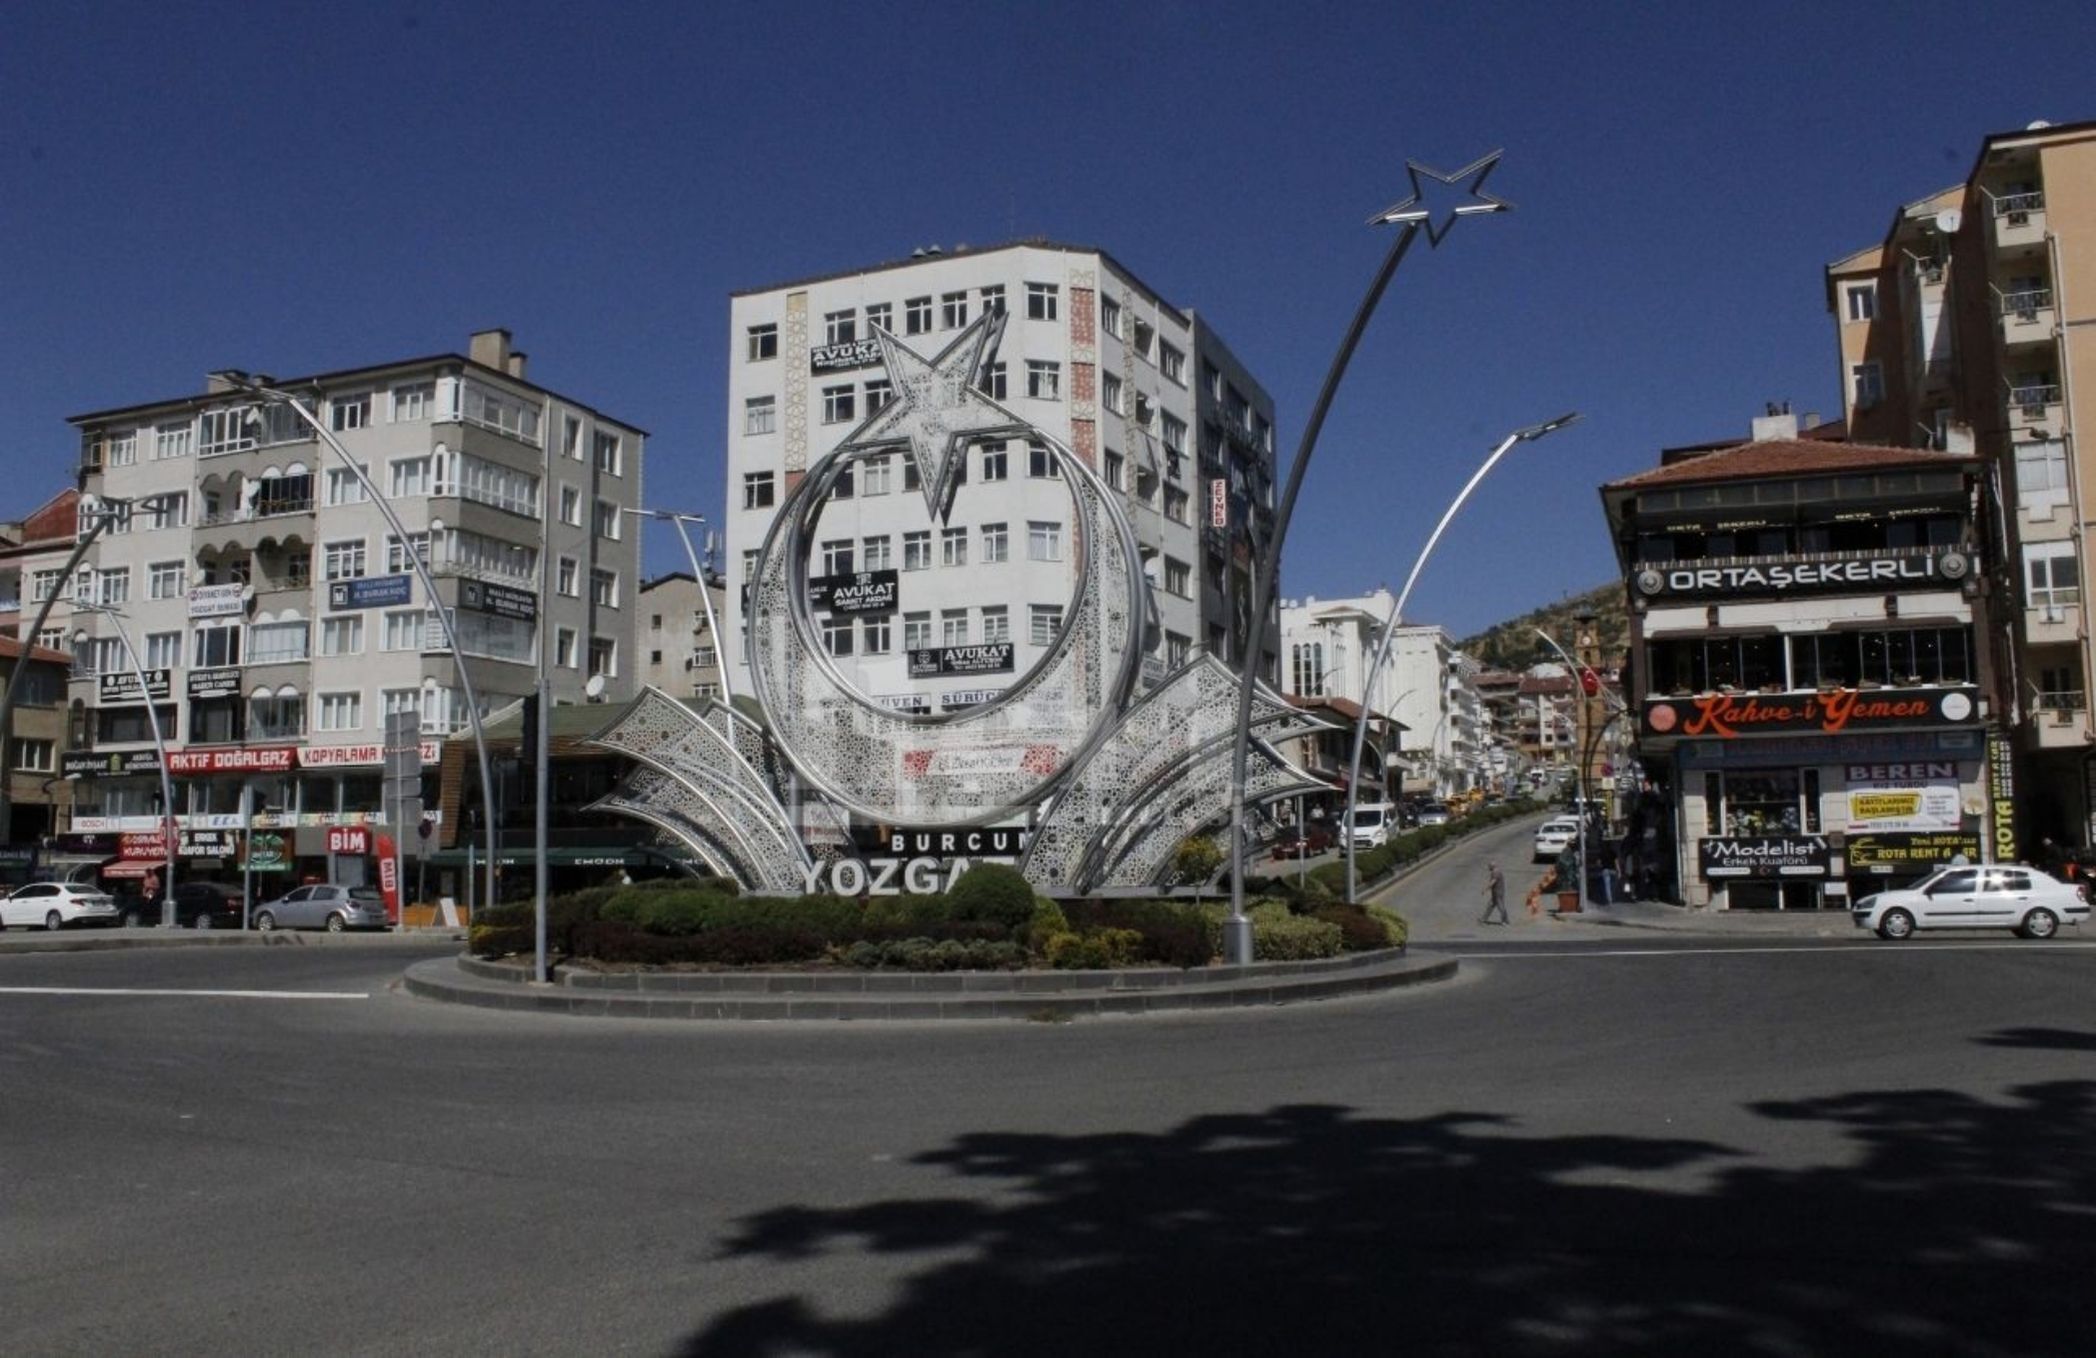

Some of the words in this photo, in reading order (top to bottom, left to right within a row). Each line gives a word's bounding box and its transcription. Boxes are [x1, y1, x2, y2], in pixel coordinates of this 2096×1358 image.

[1670, 553, 1934, 589] ORTAŞEKERLİ
[833, 582, 895, 599] AVUKAT
[944, 645, 1010, 660] AVUKAT
[1817, 687, 1930, 733] Yemen
[170, 753, 210, 769] AKTİF
[214, 750, 290, 768] DOĞALGAZ
[304, 747, 377, 764] KOPYALAMA
[1850, 763, 1953, 780] BEREN
[1995, 801, 2015, 858] ROTA
[330, 828, 365, 851] BİM
[1713, 840, 1817, 858] Modelist
[1878, 849, 1907, 858] ROTA
[1911, 847, 1940, 858] RENT
[1723, 858, 1758, 866] Erkek
